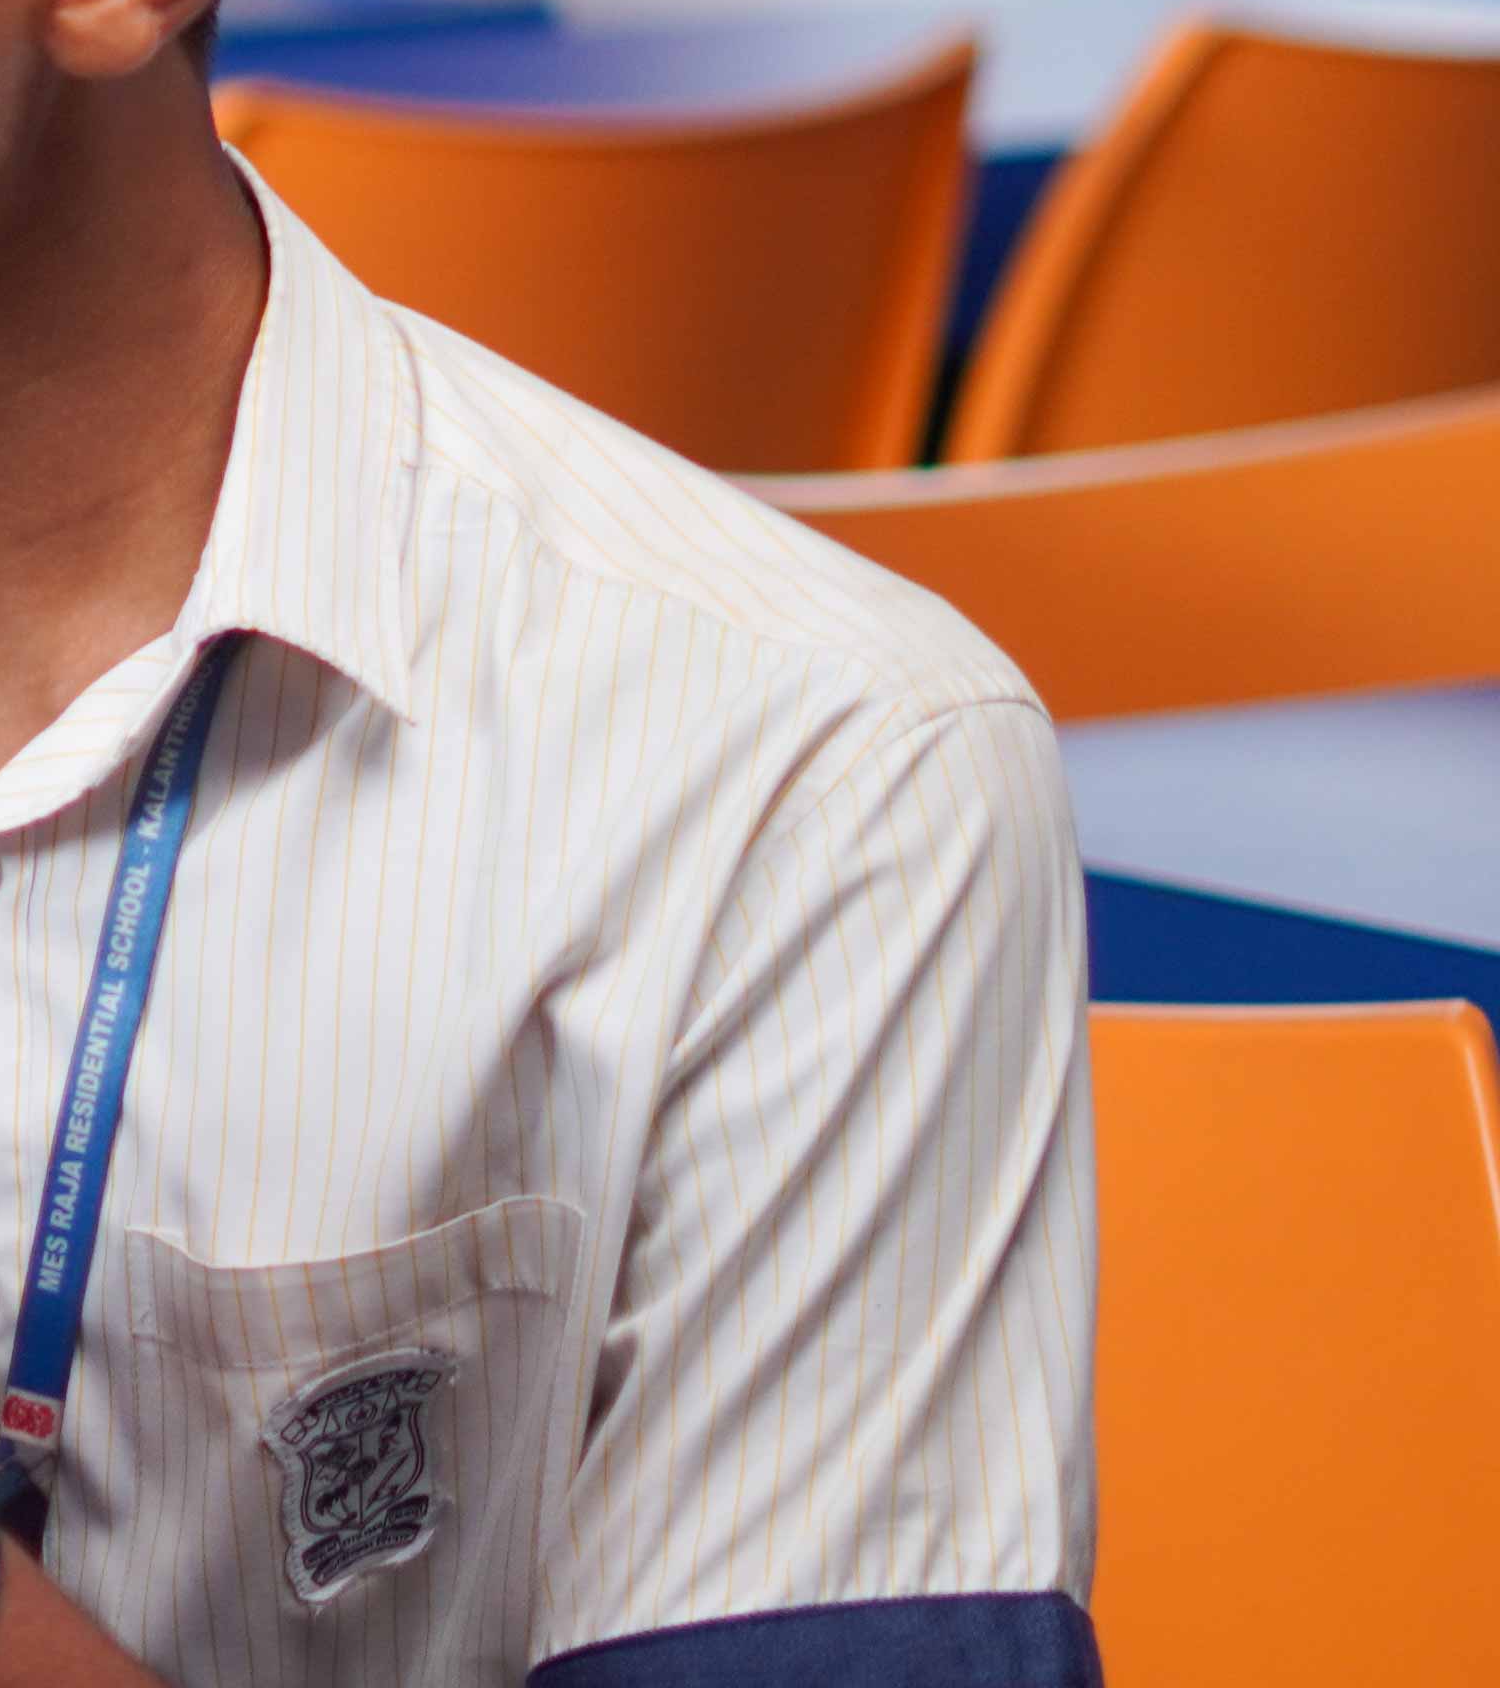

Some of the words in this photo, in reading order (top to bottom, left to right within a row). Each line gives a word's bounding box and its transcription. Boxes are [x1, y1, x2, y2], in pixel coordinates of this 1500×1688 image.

[106, 862, 151, 972] SCHOOL
[63, 978, 126, 1152] RESIDENTIAL
[49, 1159, 84, 1230] RAJA
[38, 1234, 69, 1293] MES
